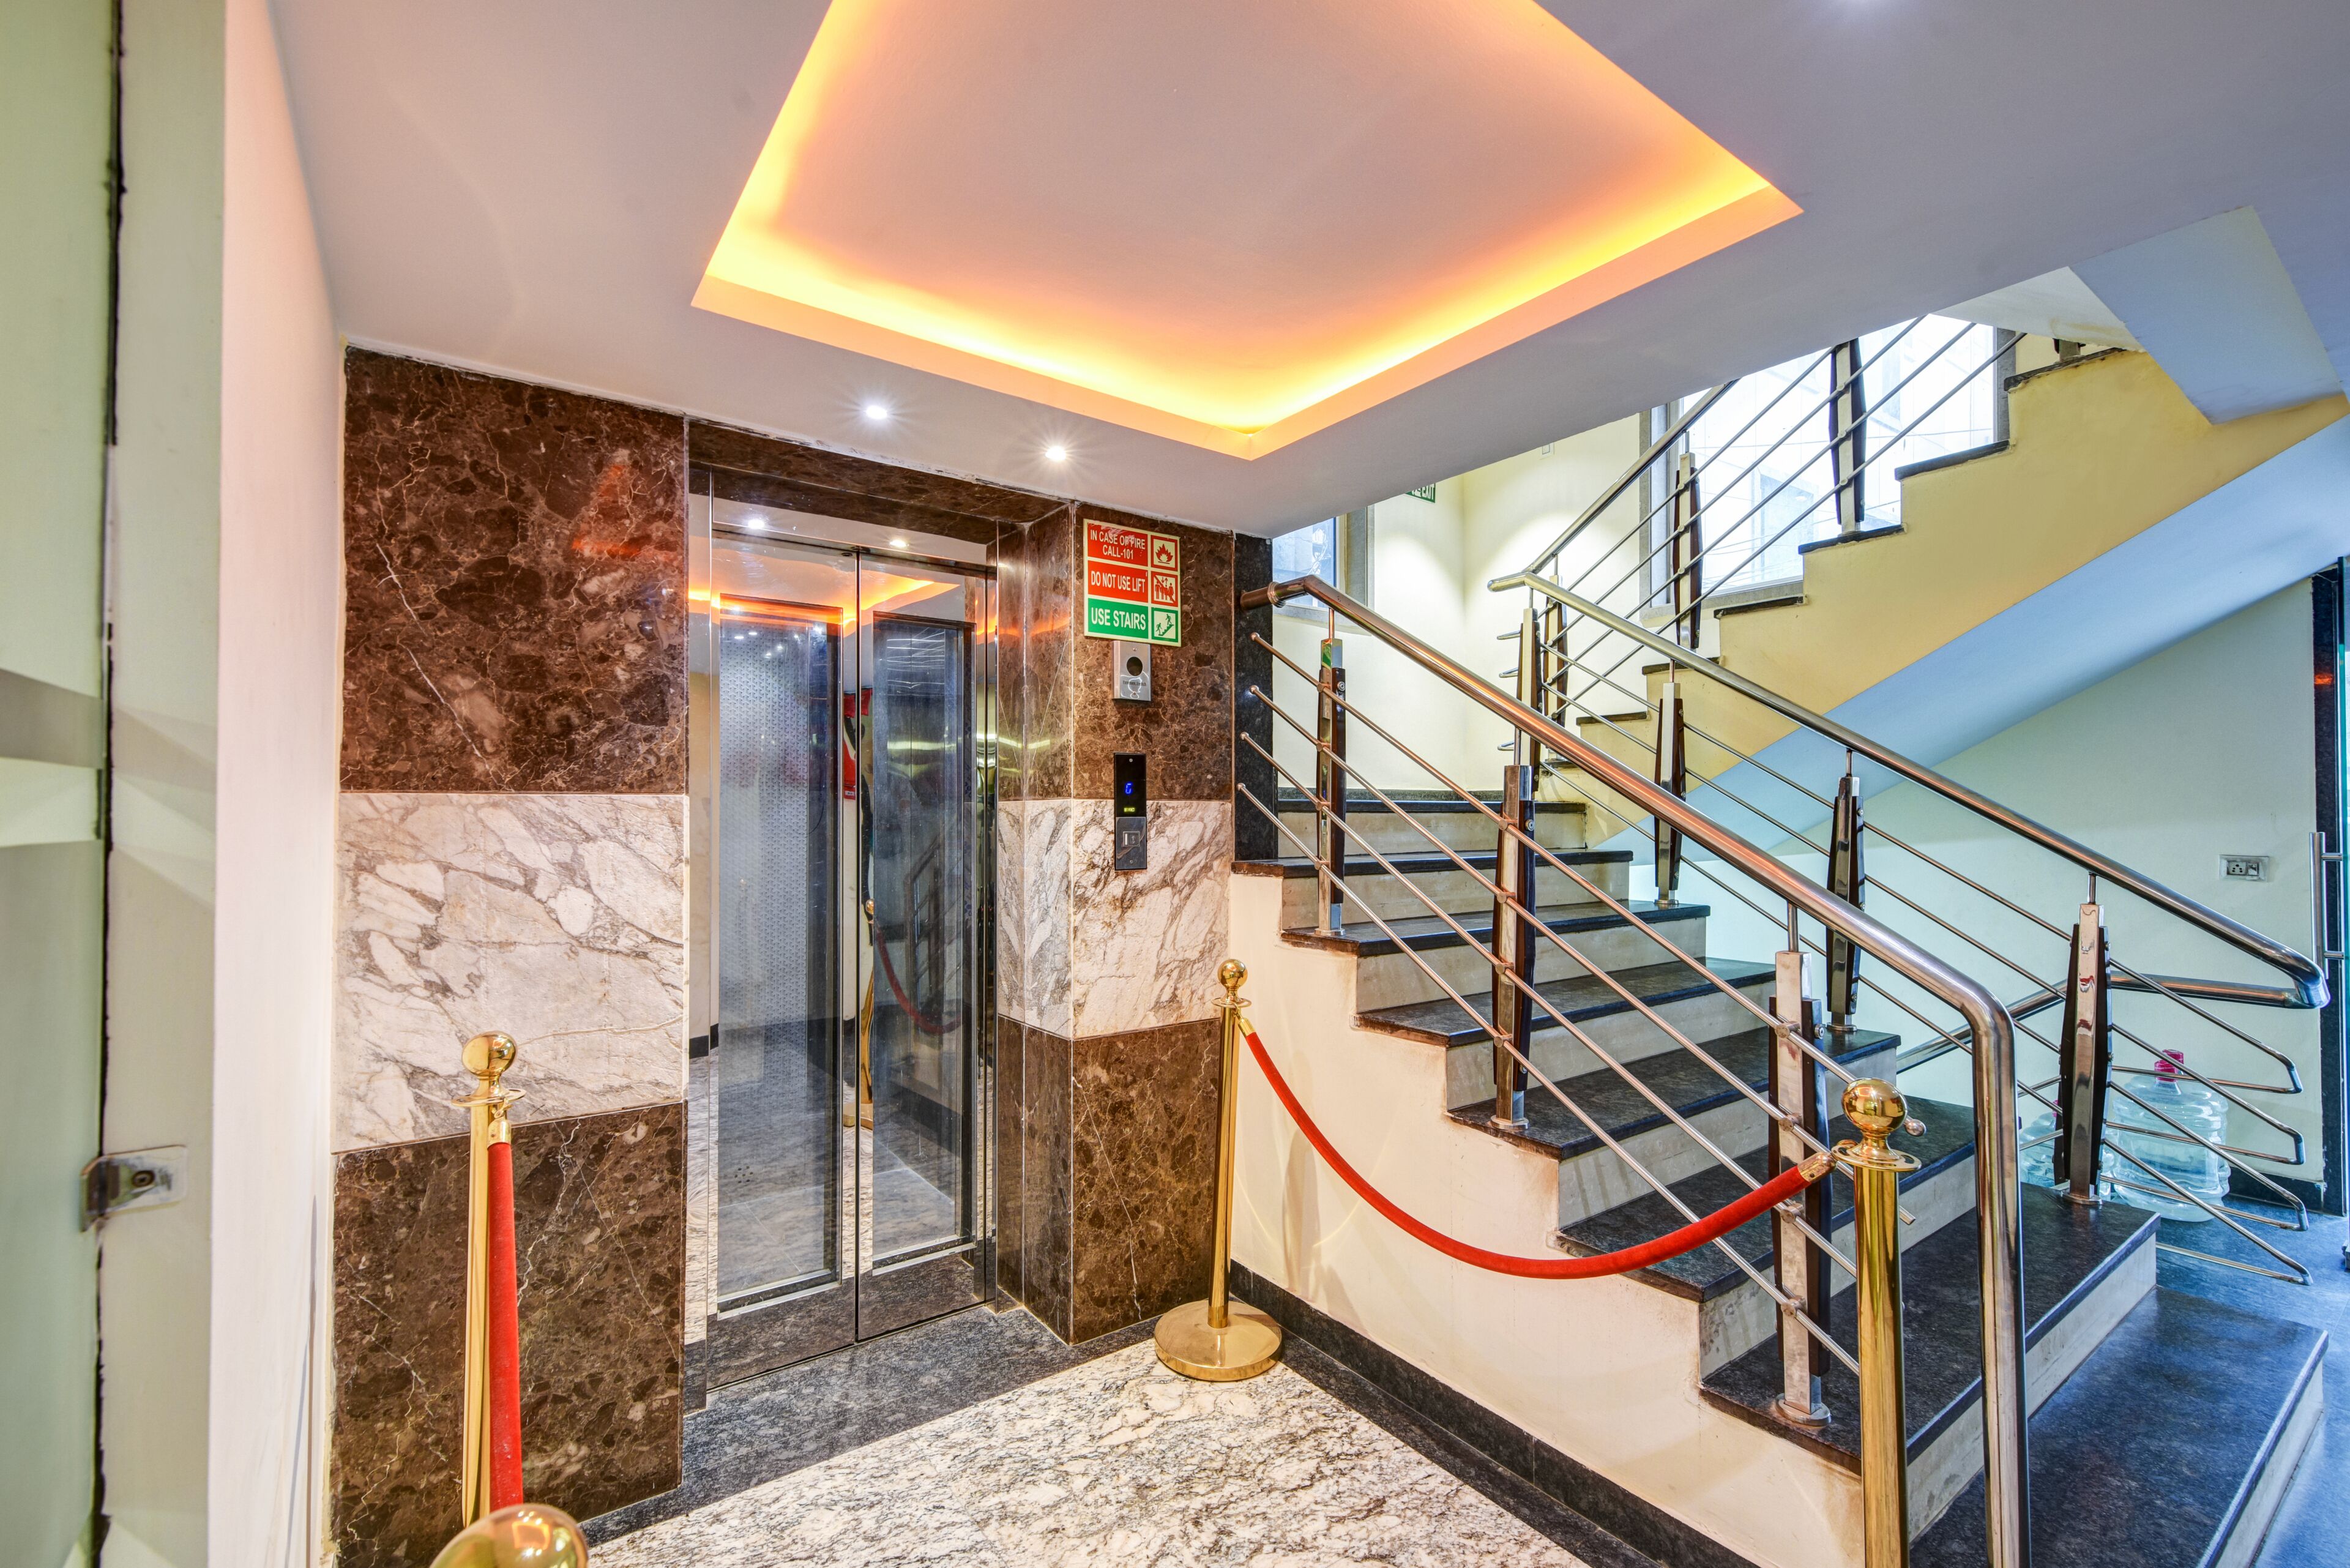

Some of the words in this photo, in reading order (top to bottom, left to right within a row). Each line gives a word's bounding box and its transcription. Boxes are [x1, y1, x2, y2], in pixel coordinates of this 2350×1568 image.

[1422, 483, 1434, 500] EXIT
[1091, 529, 1097, 541] IN
[1099, 531, 1118, 545] CASE
[1102, 545, 1133, 560] CALL-101
[1091, 570, 1101, 586] DO
[1102, 572, 1116, 588] NOT
[1117, 575, 1131, 591] USE
[1132, 577, 1145, 593] LIFT
[1091, 607, 1111, 626] USE
[1113, 610, 1146, 630] STAIRS
